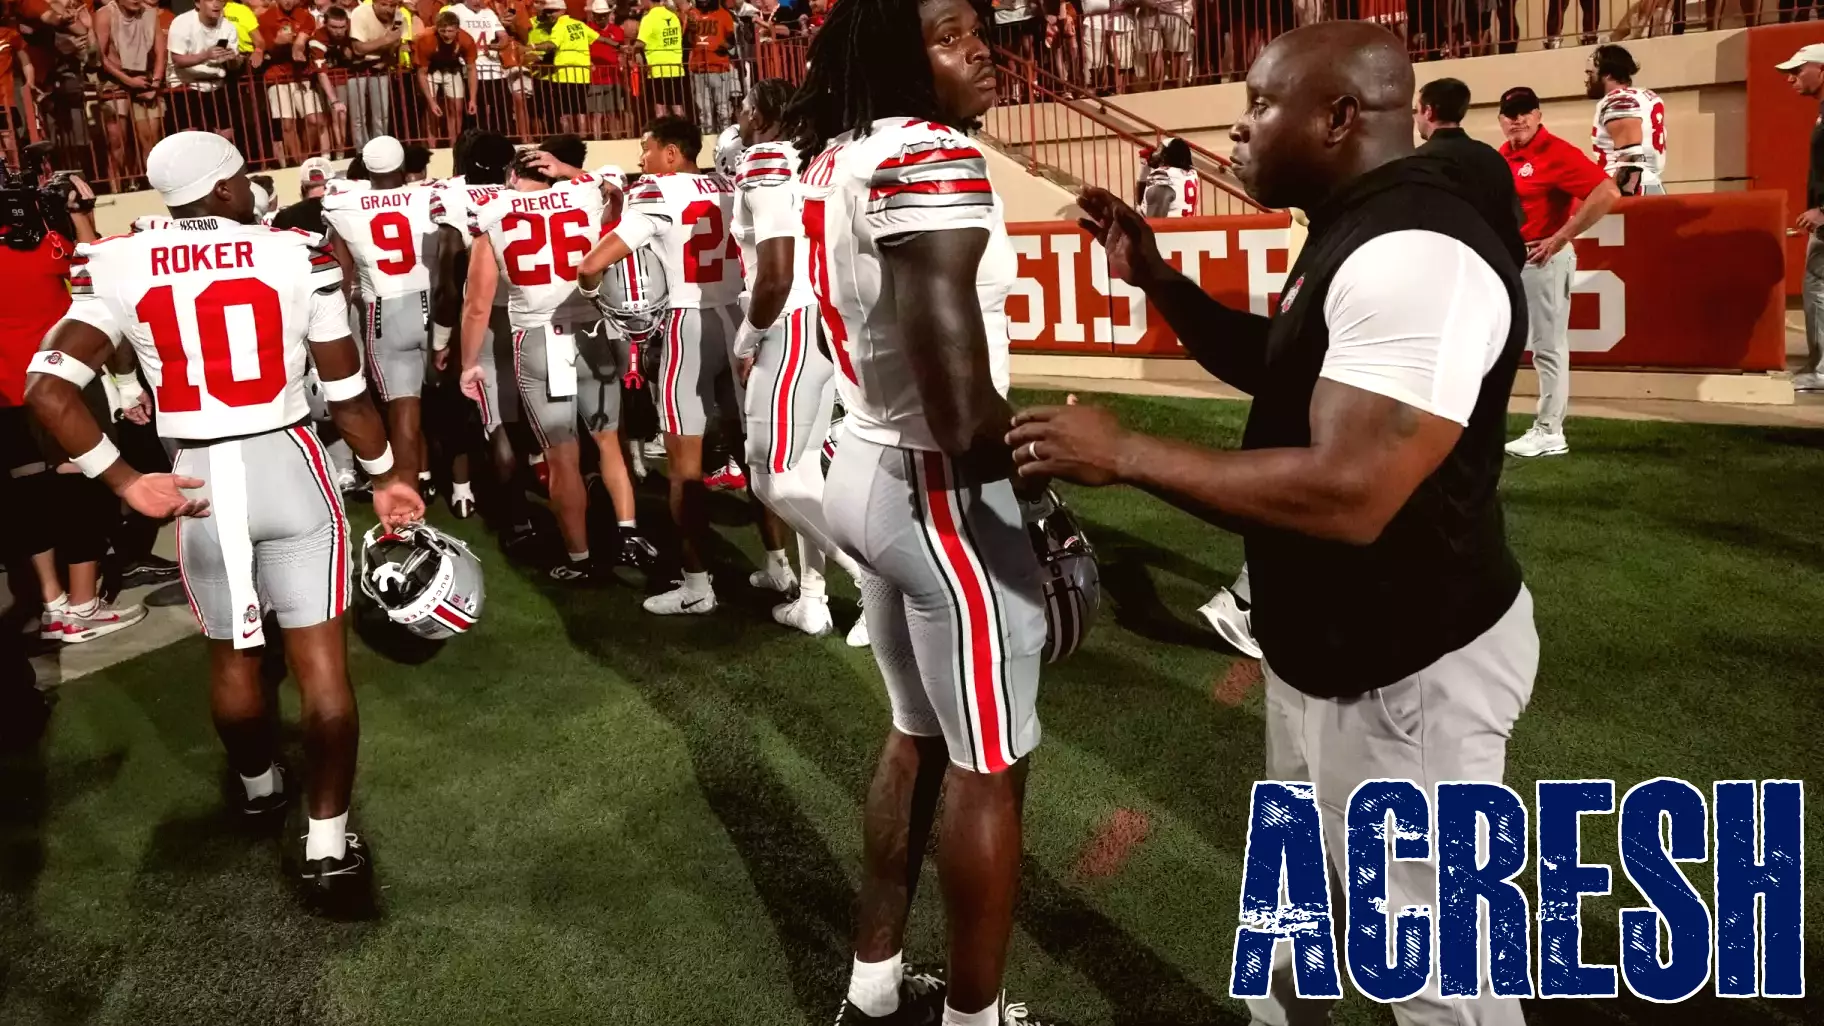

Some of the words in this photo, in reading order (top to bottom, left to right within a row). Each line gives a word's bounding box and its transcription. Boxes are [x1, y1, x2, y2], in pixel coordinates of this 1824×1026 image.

[465, 20, 492, 28] TEXAS
[663, 36, 679, 47] STAFF
[360, 192, 412, 211] GRADY
[511, 191, 573, 213] PIERCE
[179, 218, 219, 232] NXTRND
[369, 211, 416, 276] 9
[501, 208, 591, 286] 26
[150, 241, 255, 276] ROKER
[135, 277, 287, 412] 10
[403, 574, 450, 622] BUCKEYES
